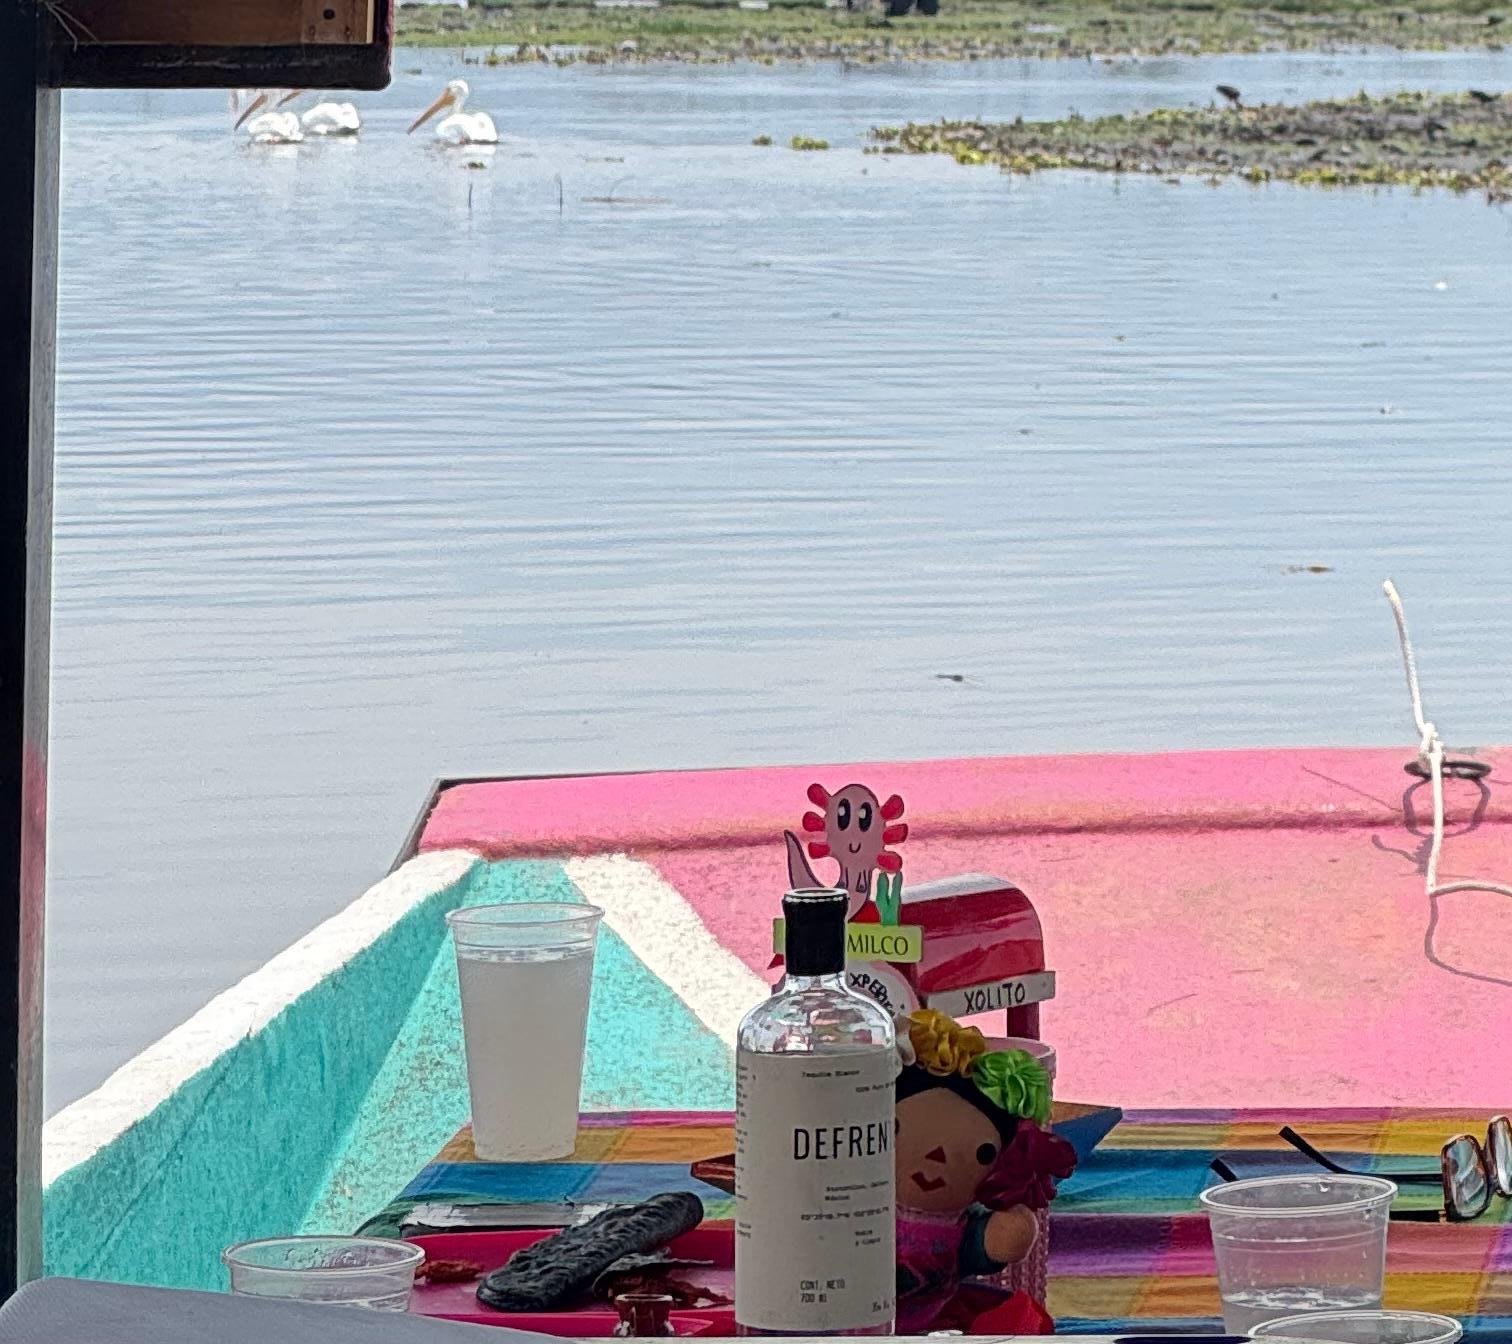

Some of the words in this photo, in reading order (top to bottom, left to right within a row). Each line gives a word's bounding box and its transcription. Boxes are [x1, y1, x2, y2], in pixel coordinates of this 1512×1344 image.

[847, 933, 909, 956] MILCO
[964, 982, 1026, 1014] XOLITO
[793, 1120, 891, 1161] DEFREN
